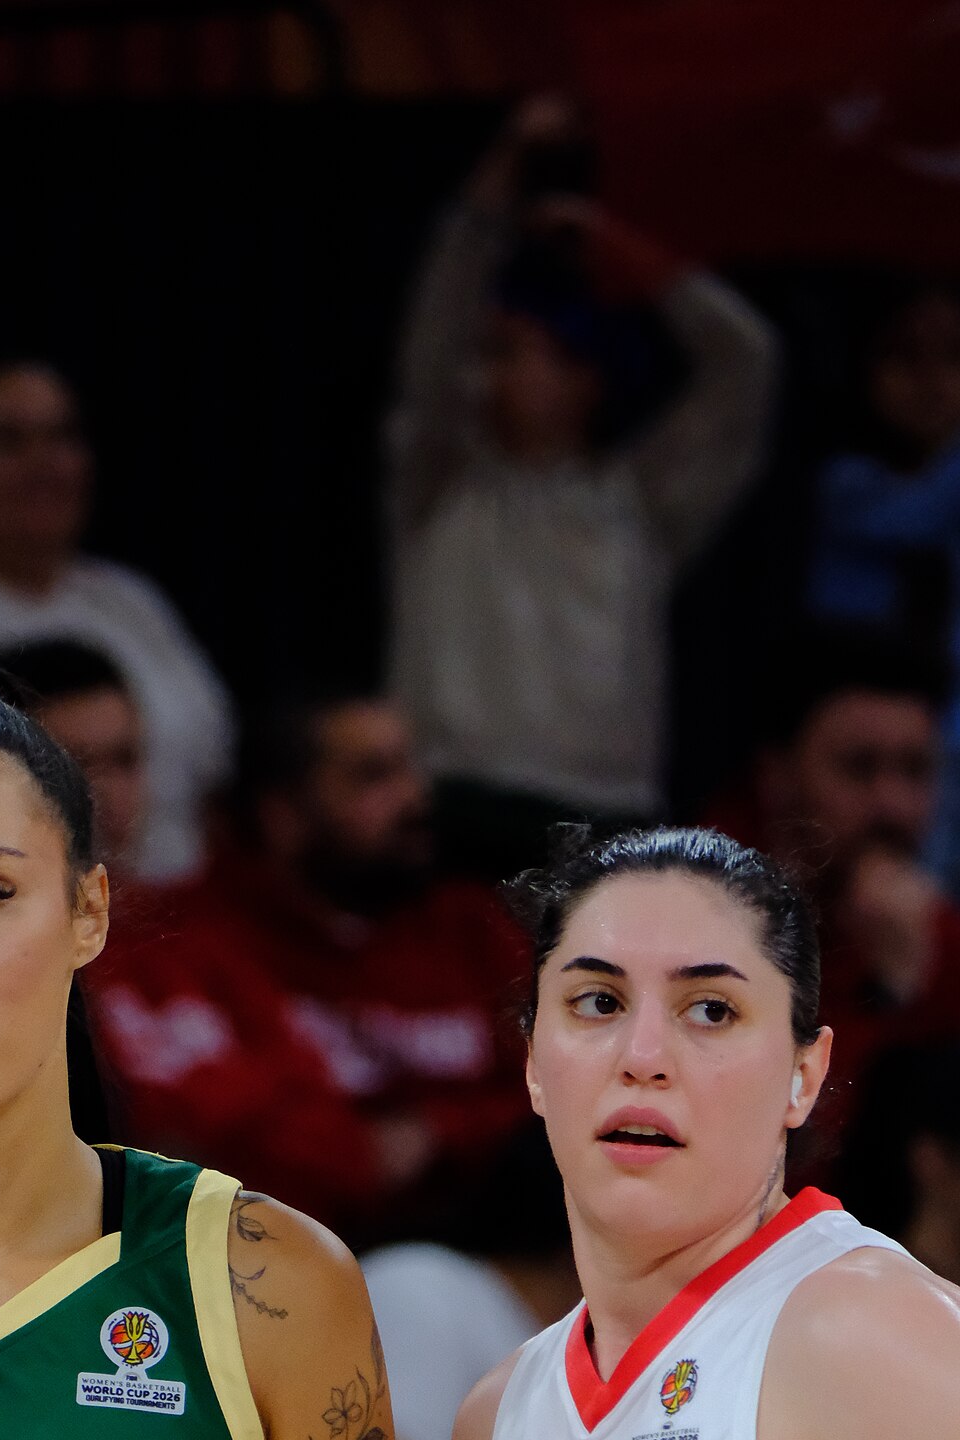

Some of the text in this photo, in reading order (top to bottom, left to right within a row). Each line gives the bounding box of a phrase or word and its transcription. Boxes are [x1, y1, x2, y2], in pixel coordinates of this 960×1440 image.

[81, 1378, 181, 1393] WOMEN'S BASKETBALL
[81, 1385, 181, 1402] WORLD CUP 2026
[85, 1394, 176, 1410] QUALIFYING TOURNAMENTS
